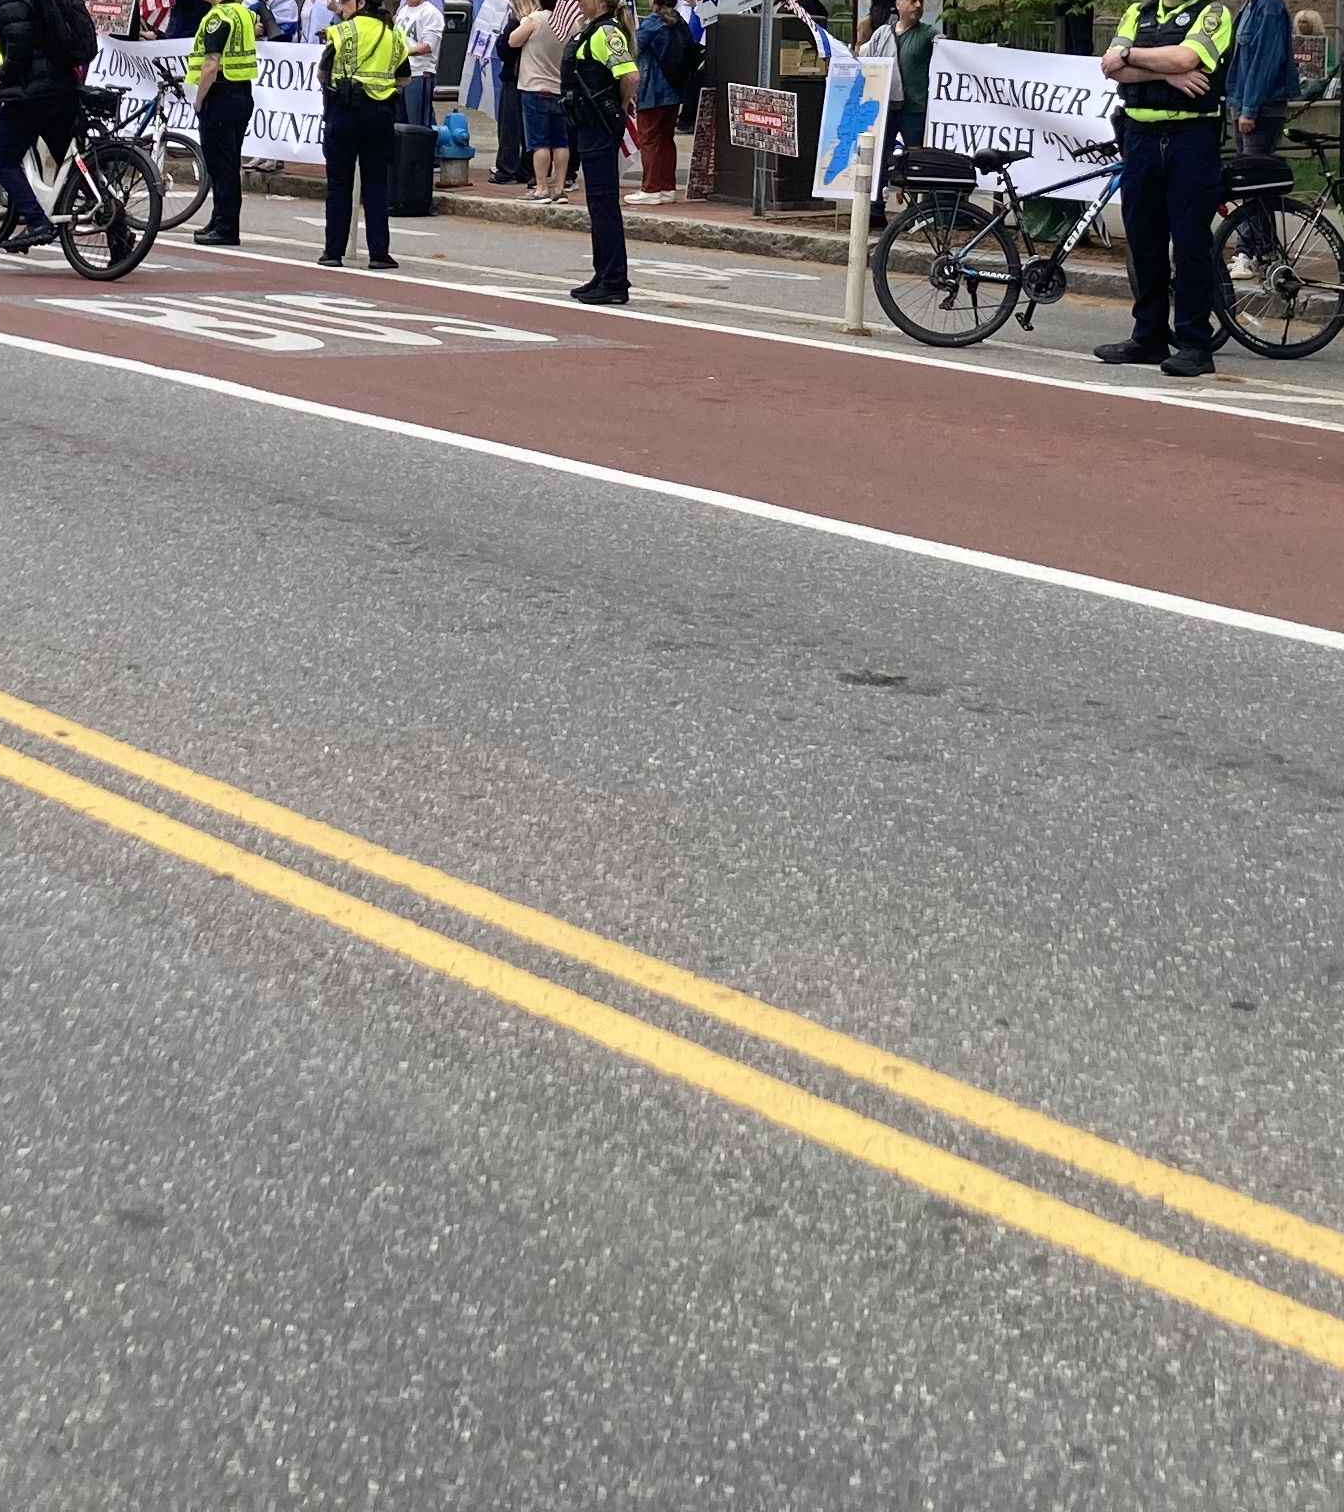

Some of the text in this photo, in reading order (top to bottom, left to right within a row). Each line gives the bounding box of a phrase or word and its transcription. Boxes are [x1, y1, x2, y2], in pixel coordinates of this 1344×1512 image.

[932, 71, 1091, 116] REMEMBER
[743, 112, 782, 128] KIDNAPPED
[930, 120, 1034, 158] JEWISH
[1063, 200, 1103, 253] GIANT
[978, 270, 1012, 281] GIANT
[35, 293, 559, 351] BUS
